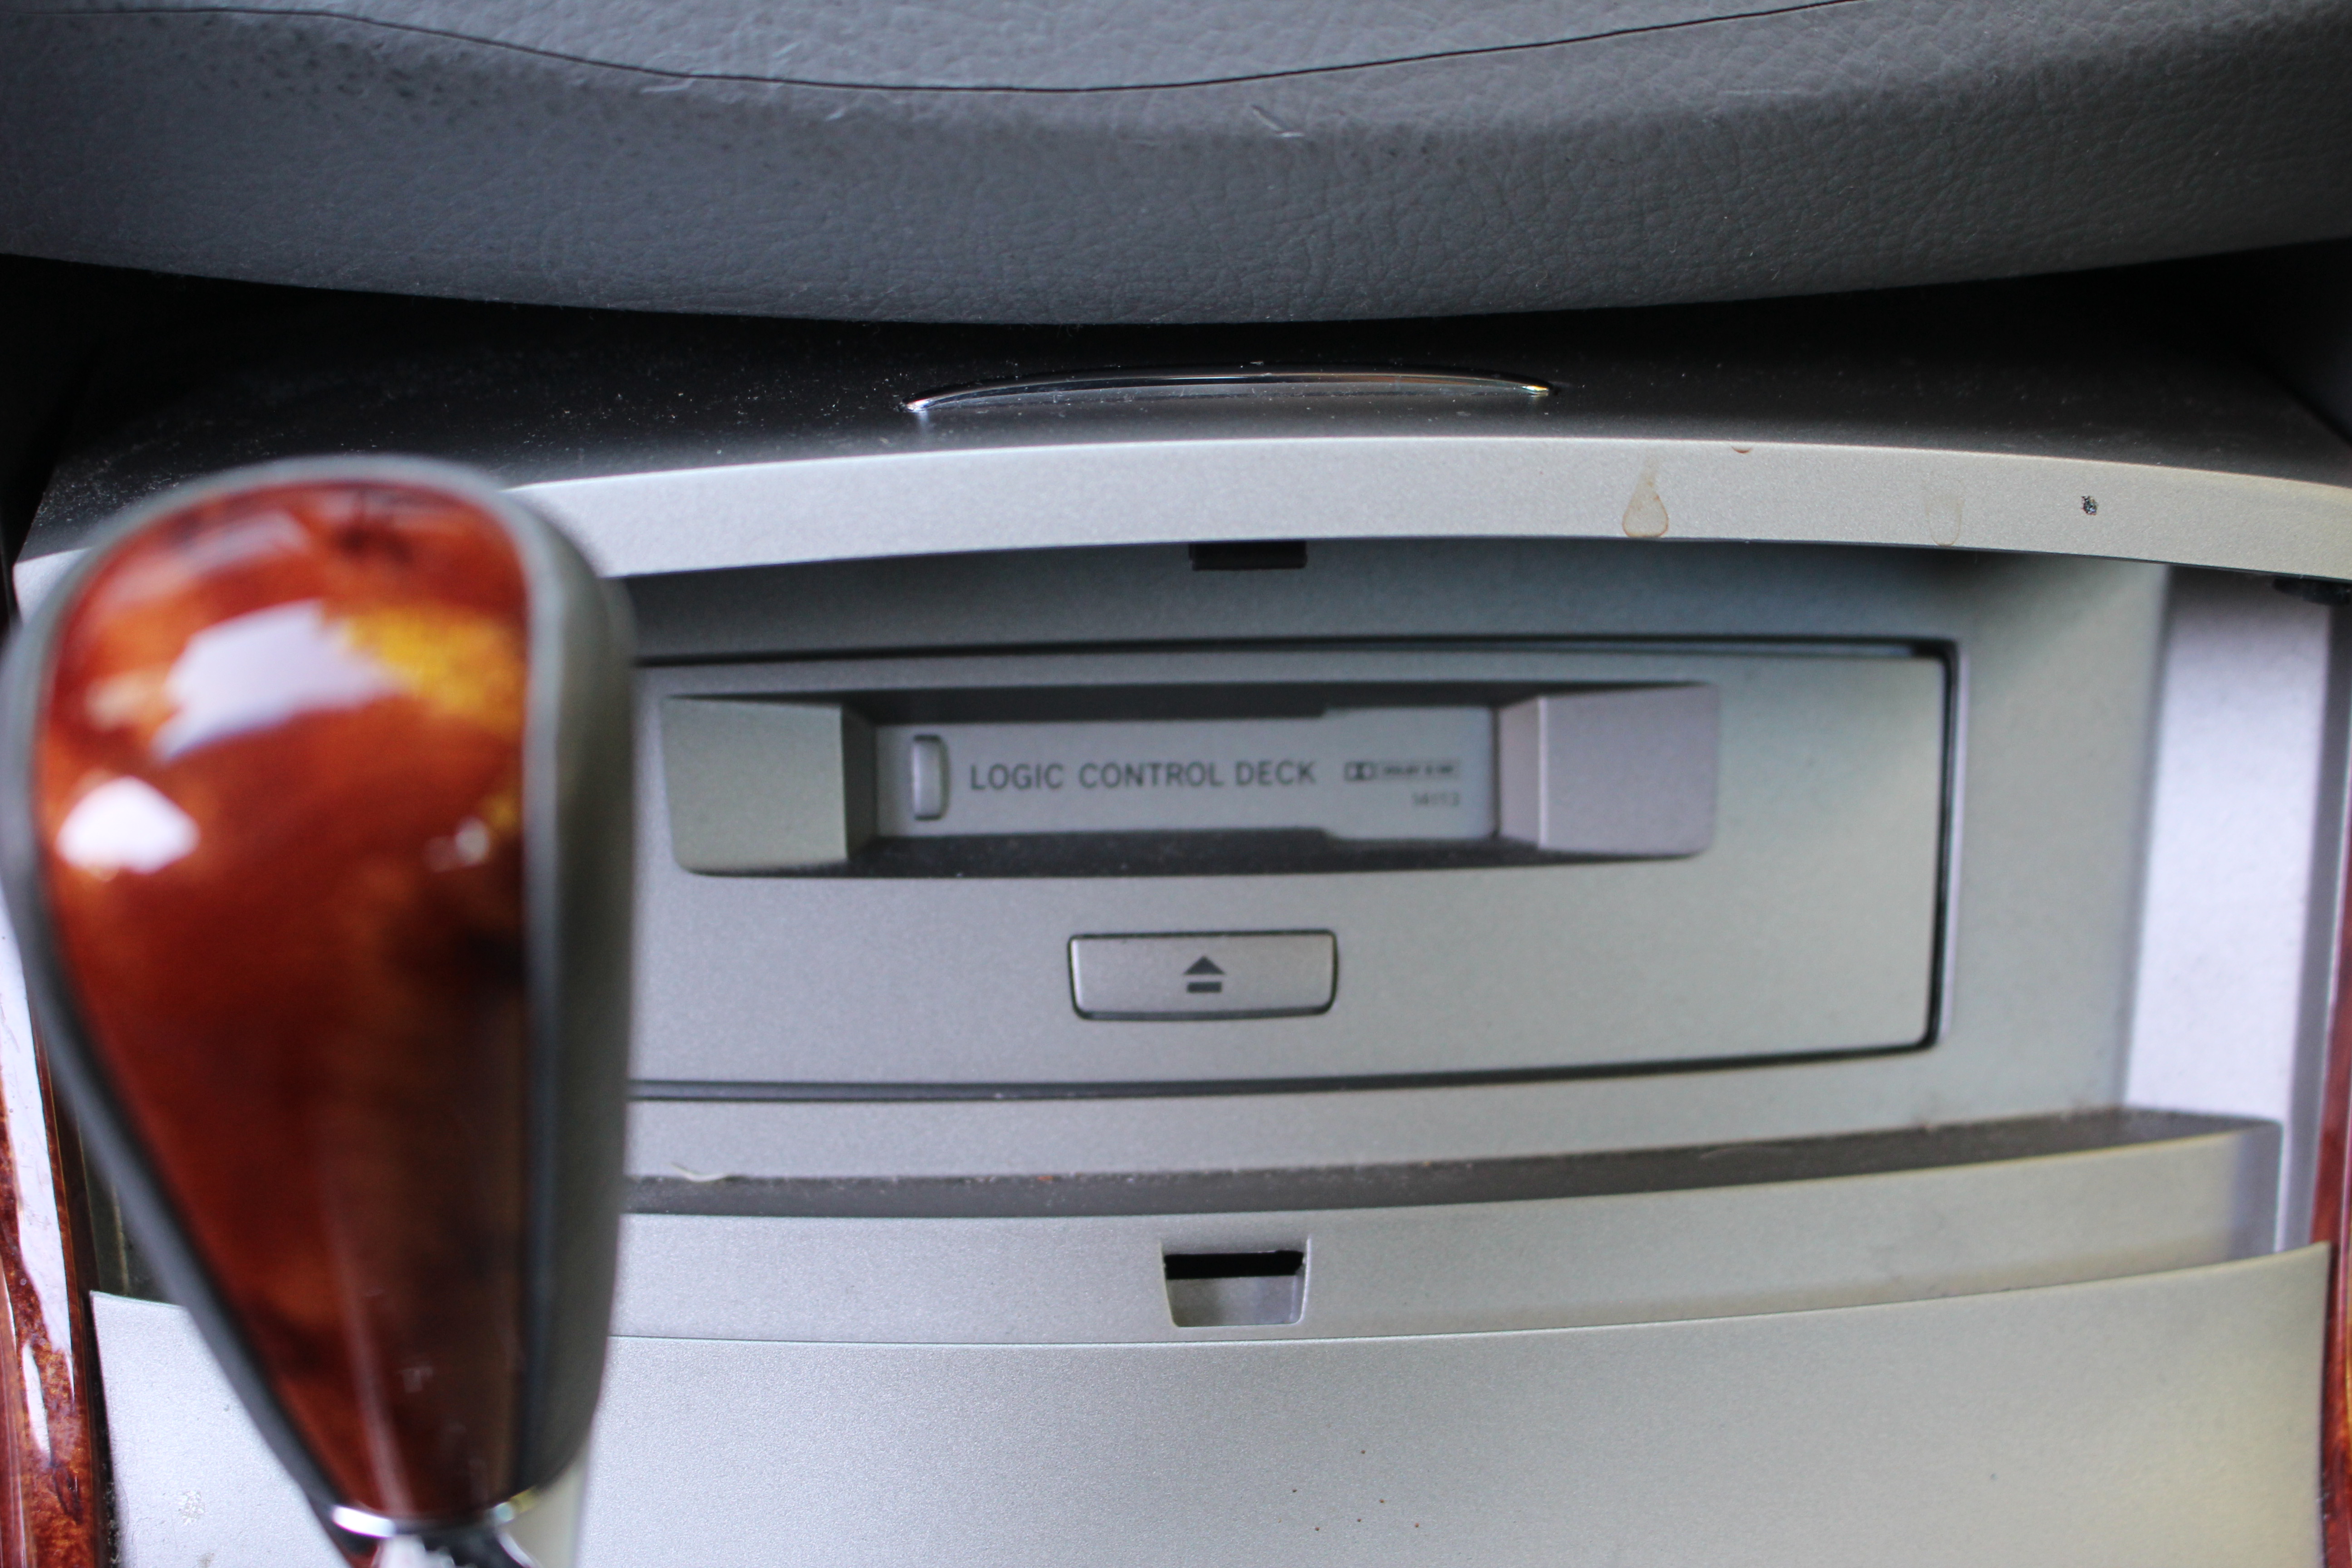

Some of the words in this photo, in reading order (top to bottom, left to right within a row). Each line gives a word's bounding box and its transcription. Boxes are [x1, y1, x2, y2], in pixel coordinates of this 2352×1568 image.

[970, 763, 1063, 791] LOGIC
[1079, 761, 1225, 789] CONTROL
[1235, 760, 1316, 786] DECK
